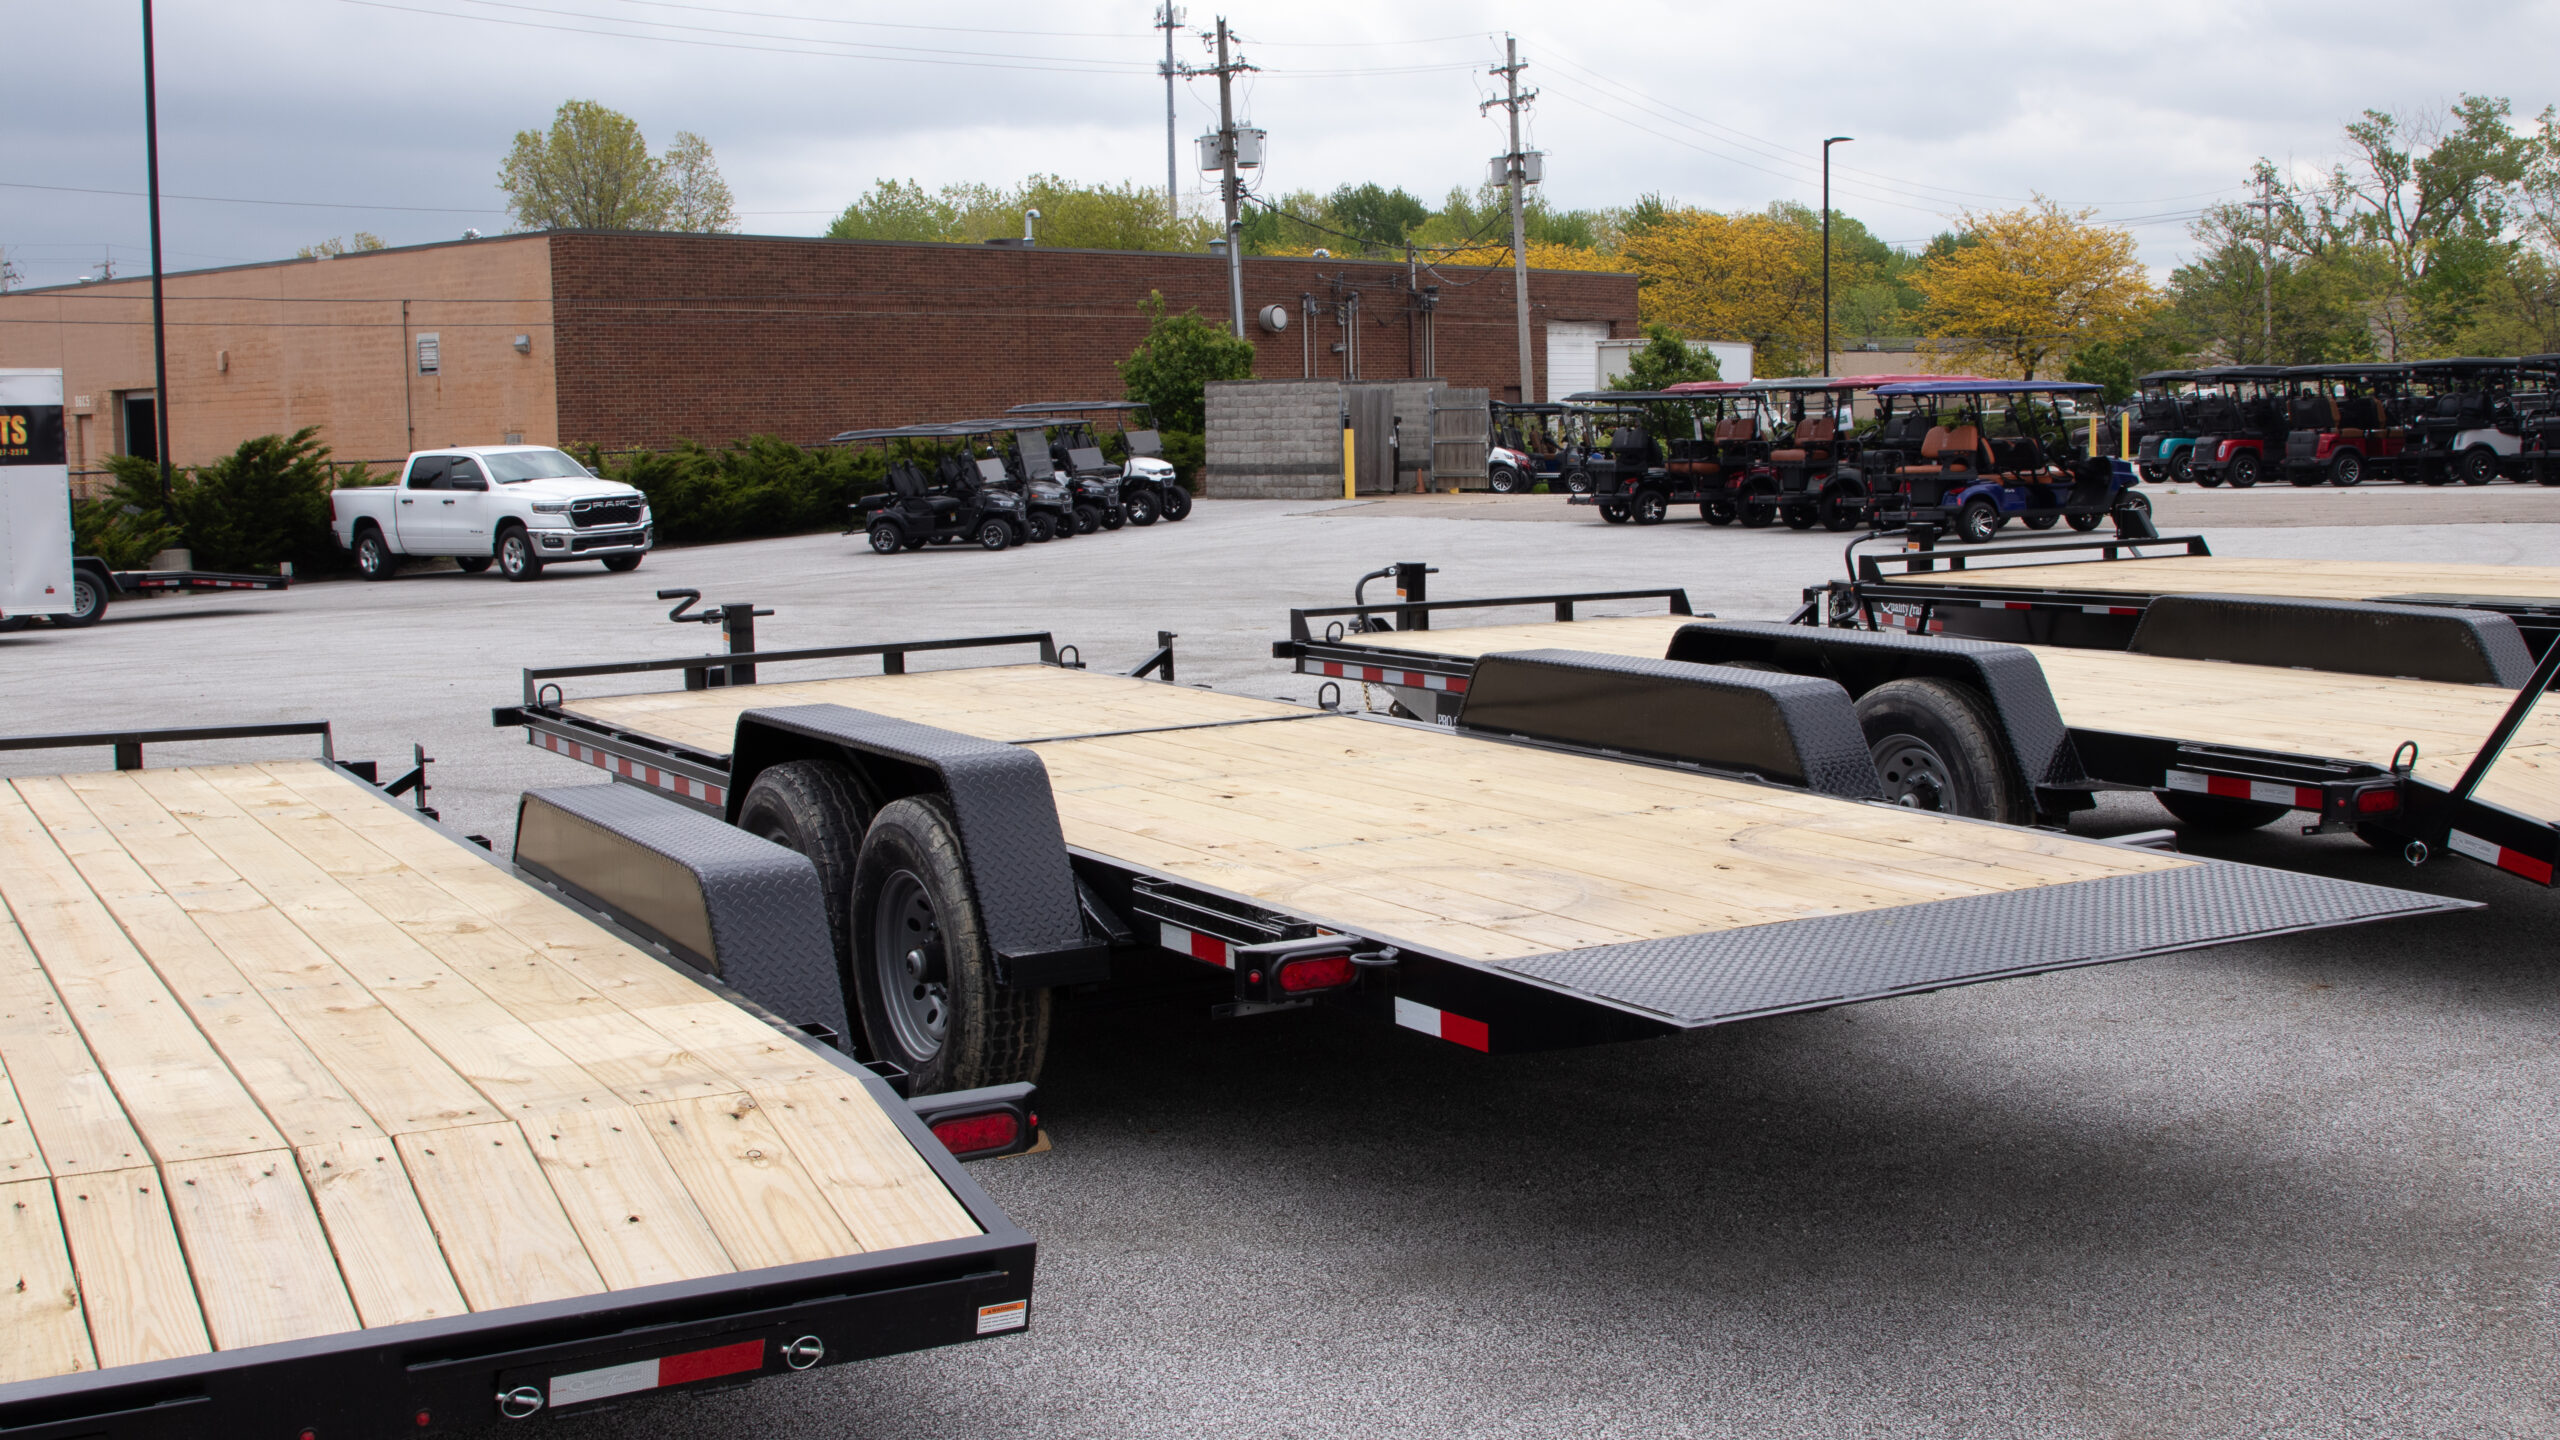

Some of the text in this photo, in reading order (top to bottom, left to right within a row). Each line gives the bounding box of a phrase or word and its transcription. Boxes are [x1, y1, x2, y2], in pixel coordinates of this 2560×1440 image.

[592, 500, 626, 508] RAM
[1881, 602, 1909, 616] Quality
[1437, 713, 1452, 726] PRO
